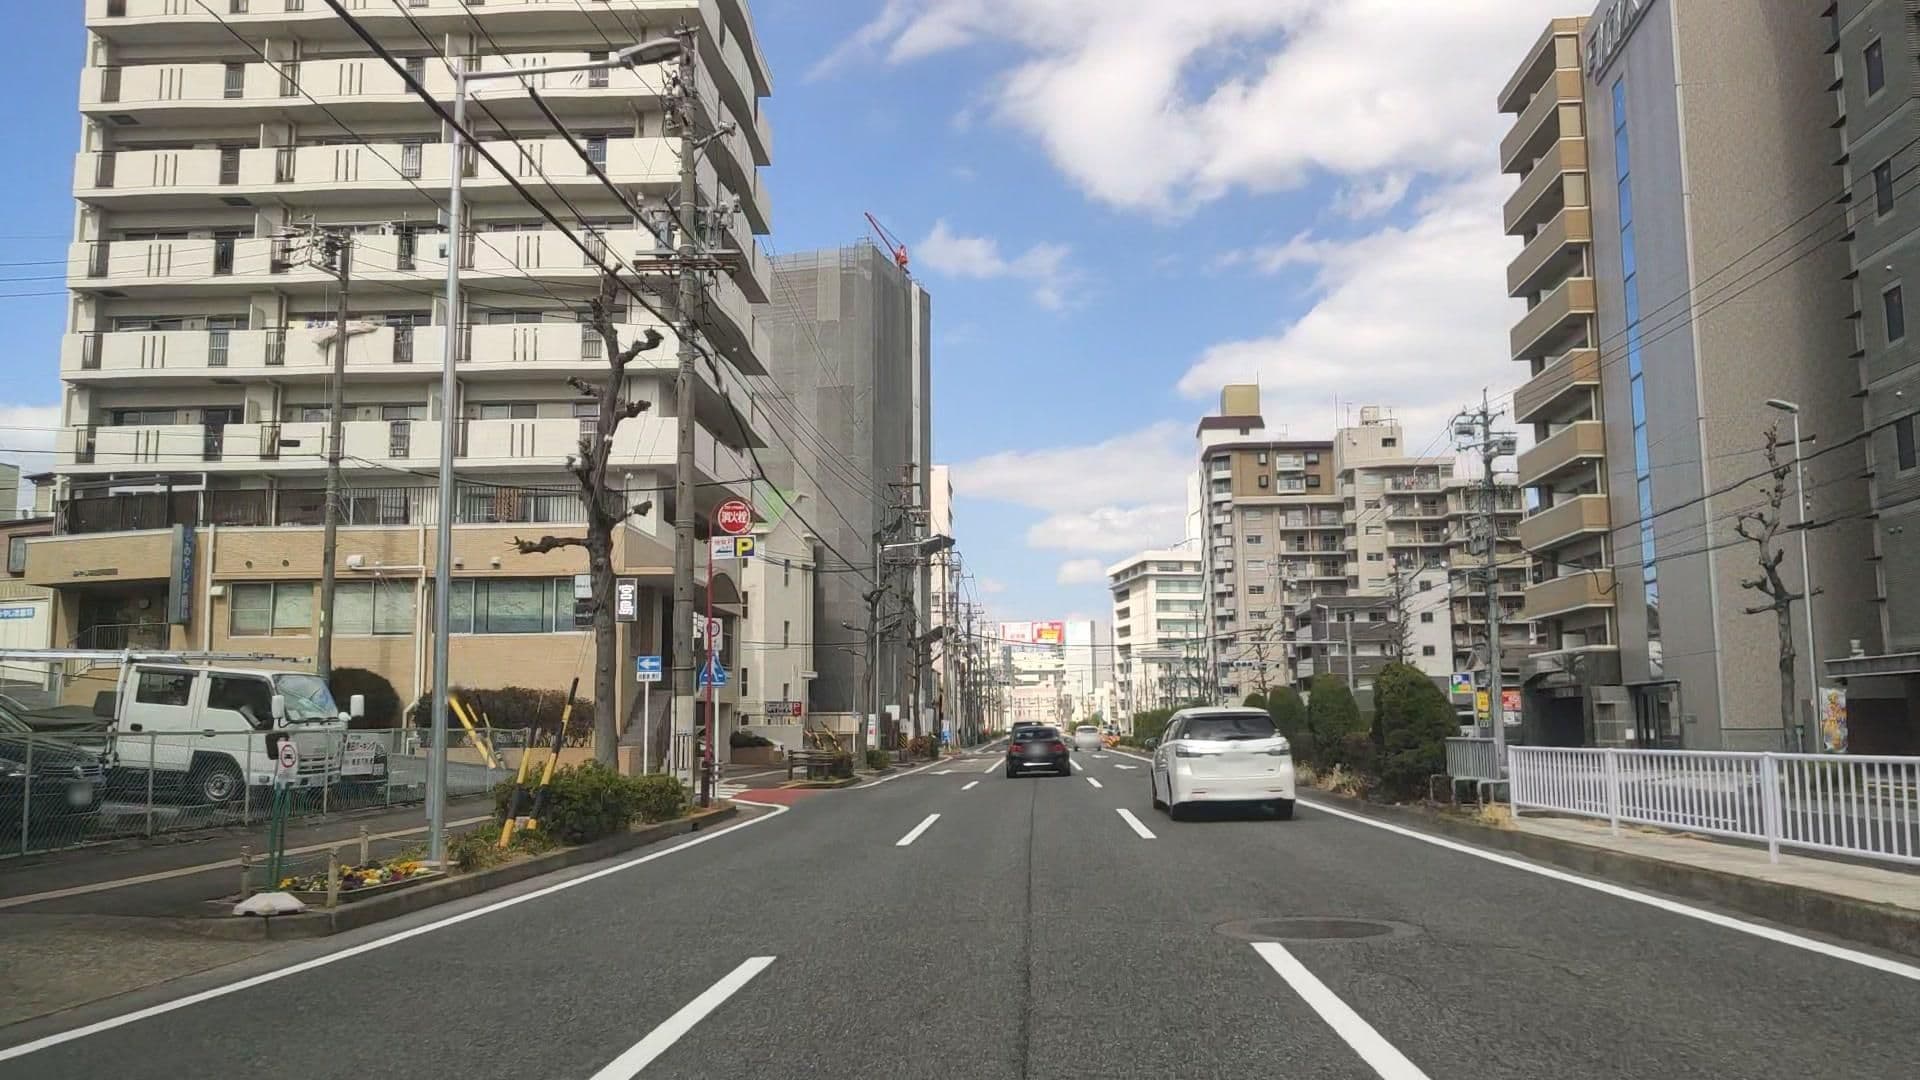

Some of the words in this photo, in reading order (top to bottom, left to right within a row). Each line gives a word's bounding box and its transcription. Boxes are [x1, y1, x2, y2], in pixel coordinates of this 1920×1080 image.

[721, 510, 748, 523] 消火栓
[736, 537, 754, 557] P
